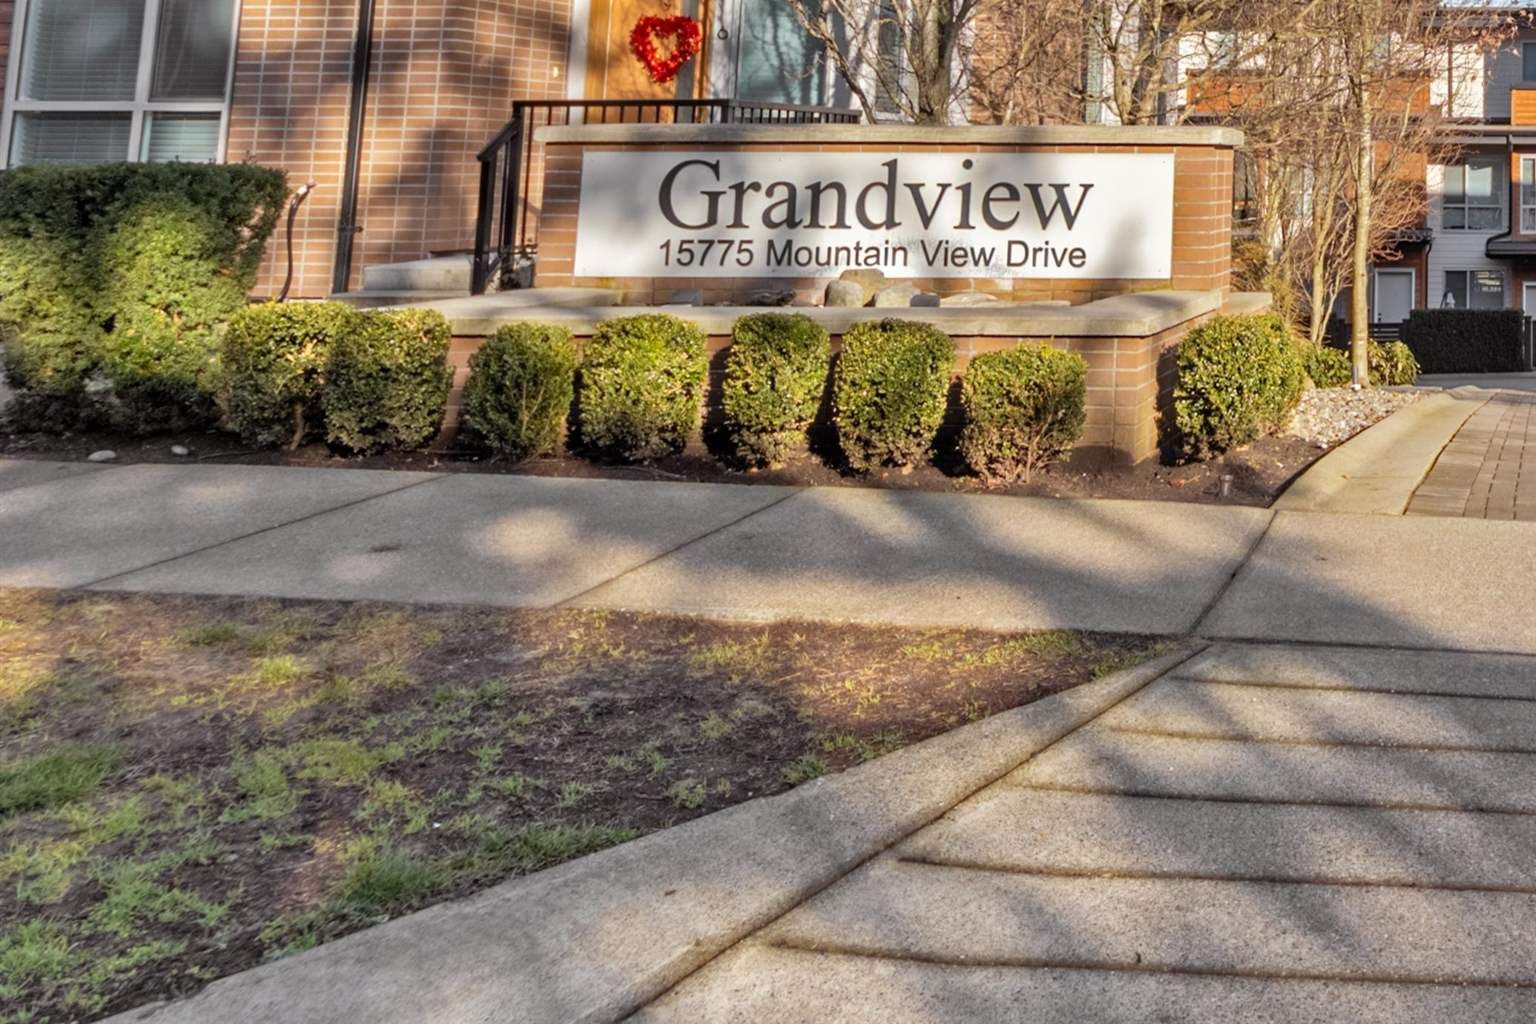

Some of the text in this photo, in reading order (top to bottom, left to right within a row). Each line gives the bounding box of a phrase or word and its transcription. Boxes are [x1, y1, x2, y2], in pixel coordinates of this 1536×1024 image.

[657, 157, 1095, 232] Grandview
[659, 238, 1087, 269] 15775 Mountain View Drive
